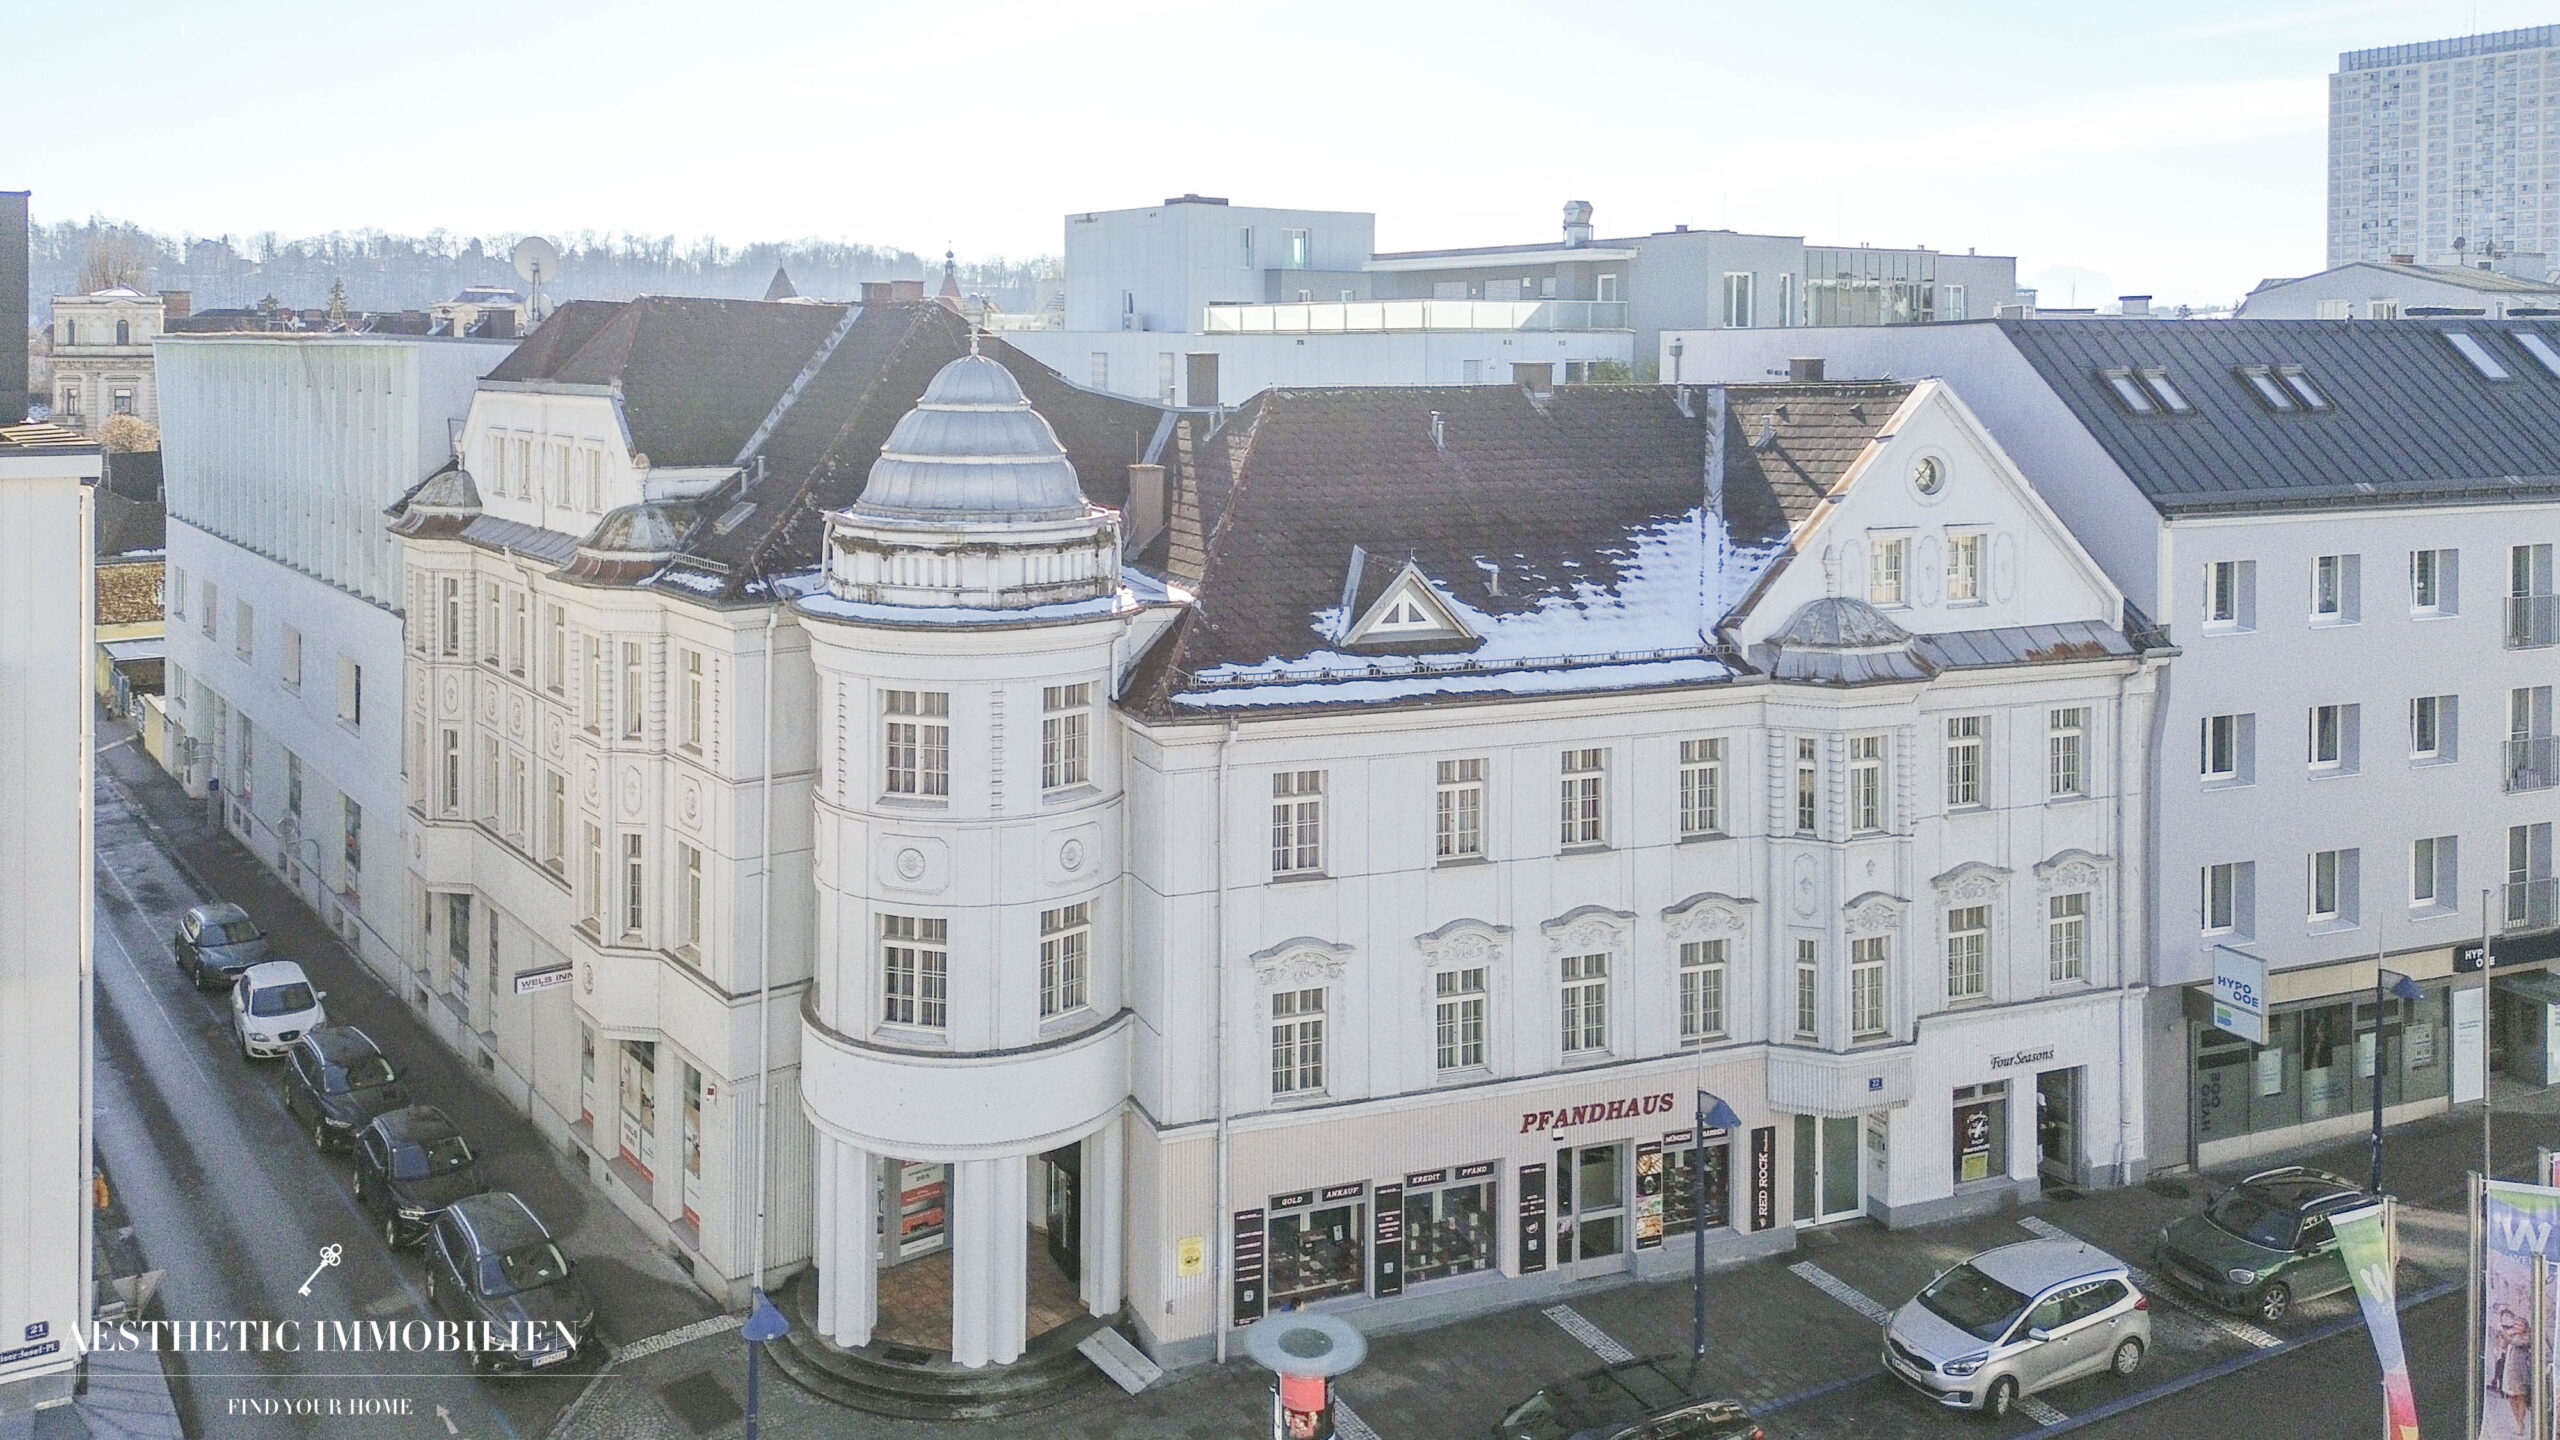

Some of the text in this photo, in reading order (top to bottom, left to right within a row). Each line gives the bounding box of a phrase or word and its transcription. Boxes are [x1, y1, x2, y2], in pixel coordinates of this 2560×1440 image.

[2464, 948, 2484, 960] HYP
[2475, 956, 2496, 968] OE
[521, 976, 552, 987] WELS
[2217, 975, 2252, 994] HYPO
[2233, 990, 2259, 1008] OOE
[1990, 1049, 2054, 1069] Four Seasons
[1520, 1093, 1674, 1134] PFANDHAUS
[1462, 1165, 1487, 1176] PFAND
[1759, 1152, 1768, 1188] ROCK
[1412, 1173, 1440, 1184] KREDIT
[1326, 1186, 1359, 1199] ANKAUF
[1281, 1196, 1303, 1206] GOLD
[1759, 1190, 1768, 1216] RED
[30, 1324, 43, 1334] 21
